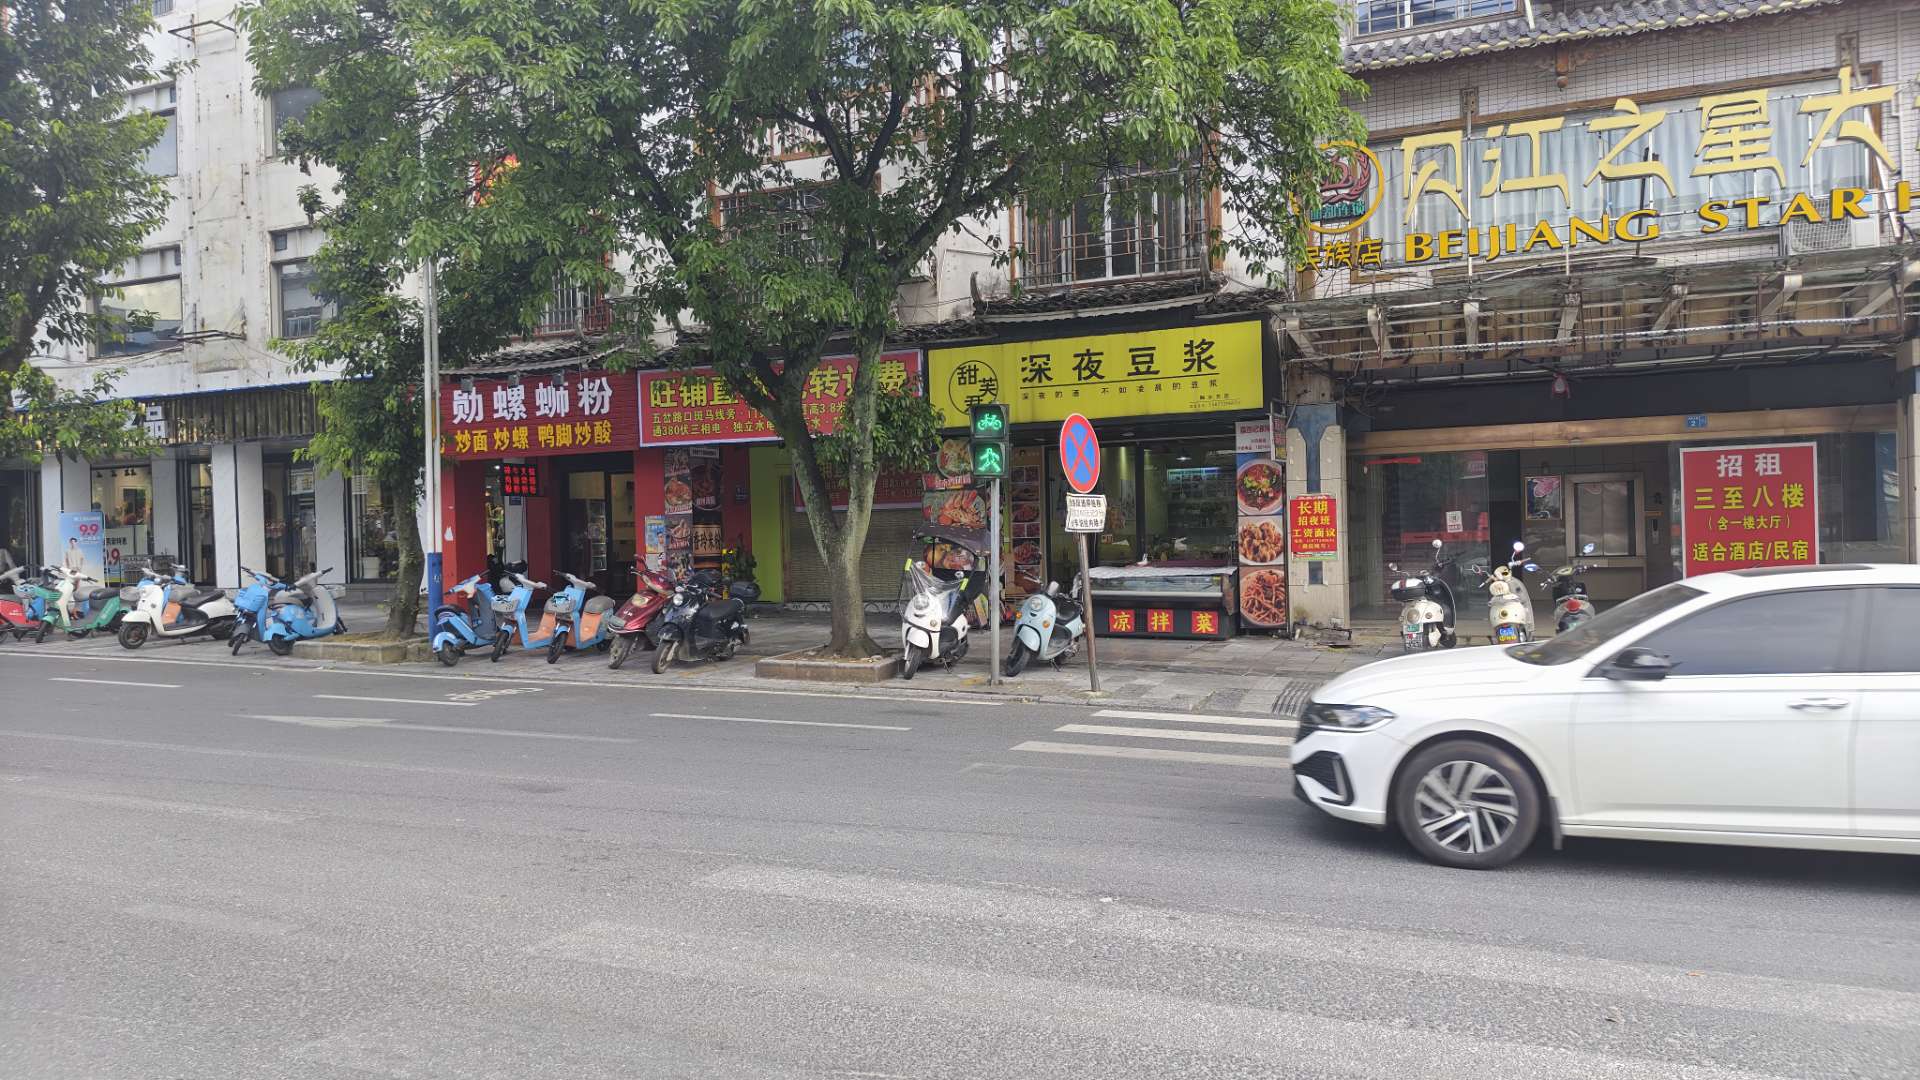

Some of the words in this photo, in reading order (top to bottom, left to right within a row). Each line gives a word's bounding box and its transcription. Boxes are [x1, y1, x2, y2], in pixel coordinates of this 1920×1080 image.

[1400, 64, 1920, 226] 贝江之星大
[1405, 209, 1660, 264] BEIJIANG
[1700, 187, 1868, 233] STAR
[1020, 338, 1218, 385] 深夜豆浆
[452, 376, 613, 424] 勋螺蛳粉
[1716, 452, 1783, 478] 招租
[1297, 499, 1328, 515] 长期
[1694, 482, 1805, 510] 三至八楼
[1292, 527, 1336, 538] 工资面议
[1692, 539, 1809, 562] 适合酒店/民宿
[1112, 611, 1215, 634] 凉拌菜
